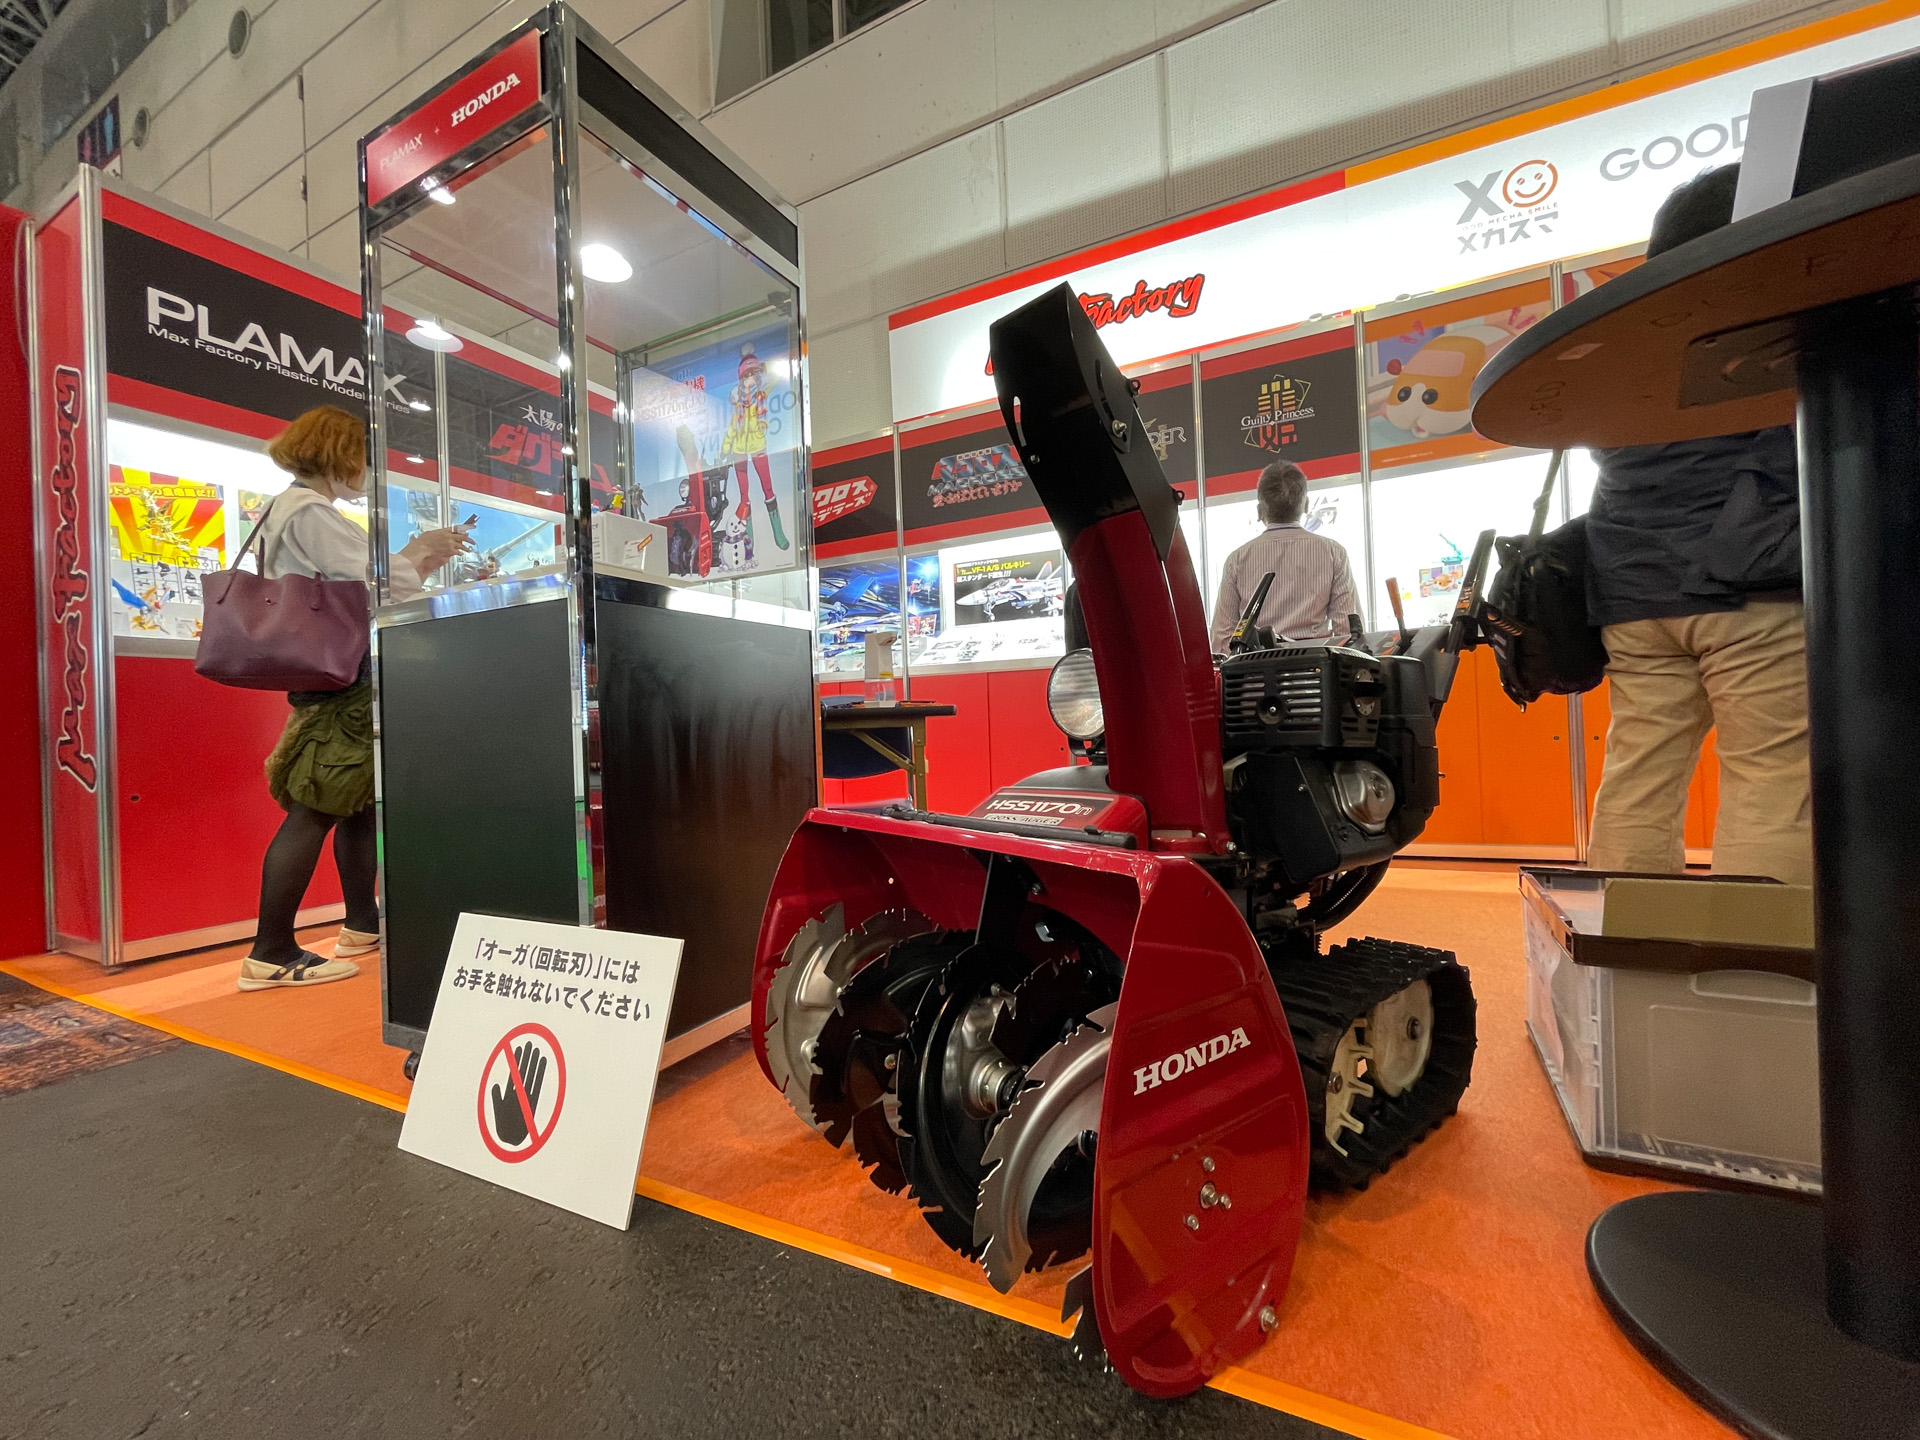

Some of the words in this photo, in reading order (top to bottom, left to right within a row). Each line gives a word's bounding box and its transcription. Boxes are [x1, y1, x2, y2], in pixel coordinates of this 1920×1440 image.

[451, 73, 521, 127] HONDA
[1528, 202, 1559, 215] SMILE
[1457, 210, 1559, 255] メカスマ
[1077, 273, 1206, 331] Factory
[148, 323, 189, 347] Max
[194, 337, 262, 371] Factory
[266, 361, 319, 386] Plastic
[322, 379, 366, 401] Model
[386, 401, 411, 415] ries
[1241, 413, 1272, 428] Guilty
[1274, 406, 1315, 421] Princess
[926, 466, 1029, 497] MACROSS
[939, 443, 1020, 481] マクロス
[813, 480, 869, 508] クロス
[986, 799, 1093, 816] HSS1170n
[475, 937, 641, 985] 「オーガ(回転刃)」には
[453, 966, 651, 1022] お手を触れないでください
[1133, 1026, 1251, 1096] HONDA
